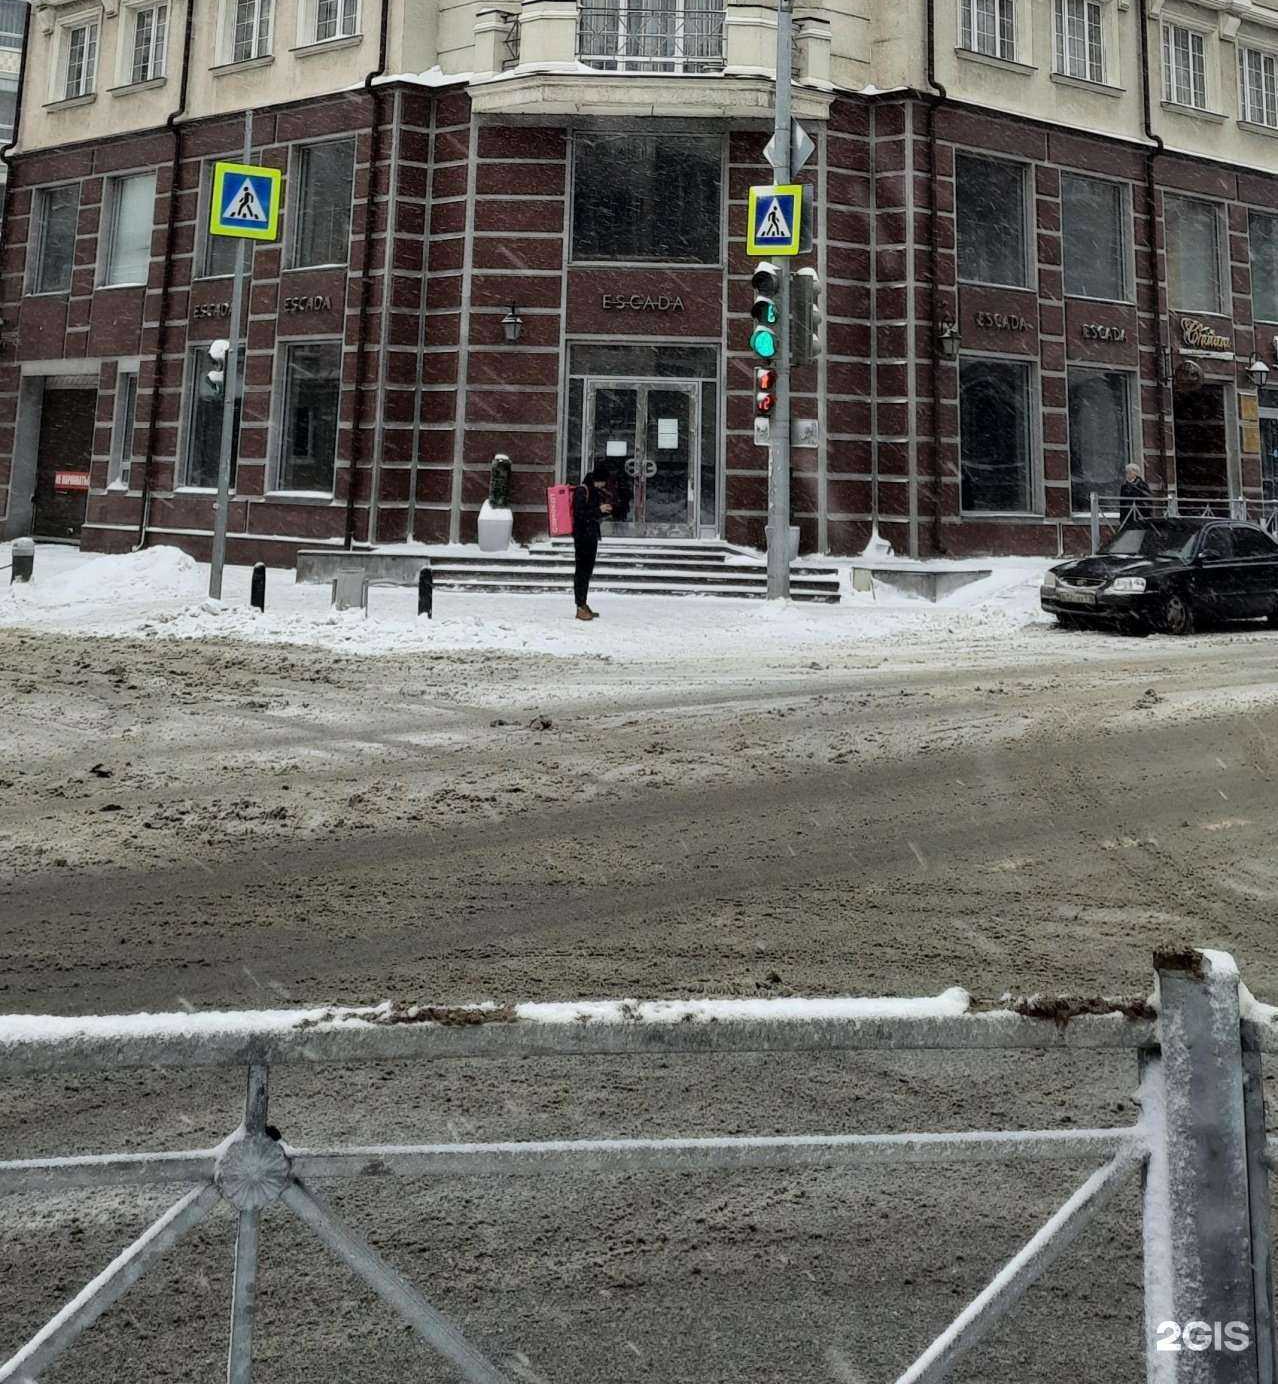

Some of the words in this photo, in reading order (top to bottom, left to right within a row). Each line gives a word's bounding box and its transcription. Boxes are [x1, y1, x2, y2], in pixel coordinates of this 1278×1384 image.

[284, 295, 331, 313] ESCADA
[602, 294, 684, 311] ESCADA
[976, 311, 1026, 332] ESCADA
[1081, 323, 1126, 342] ESCADA
